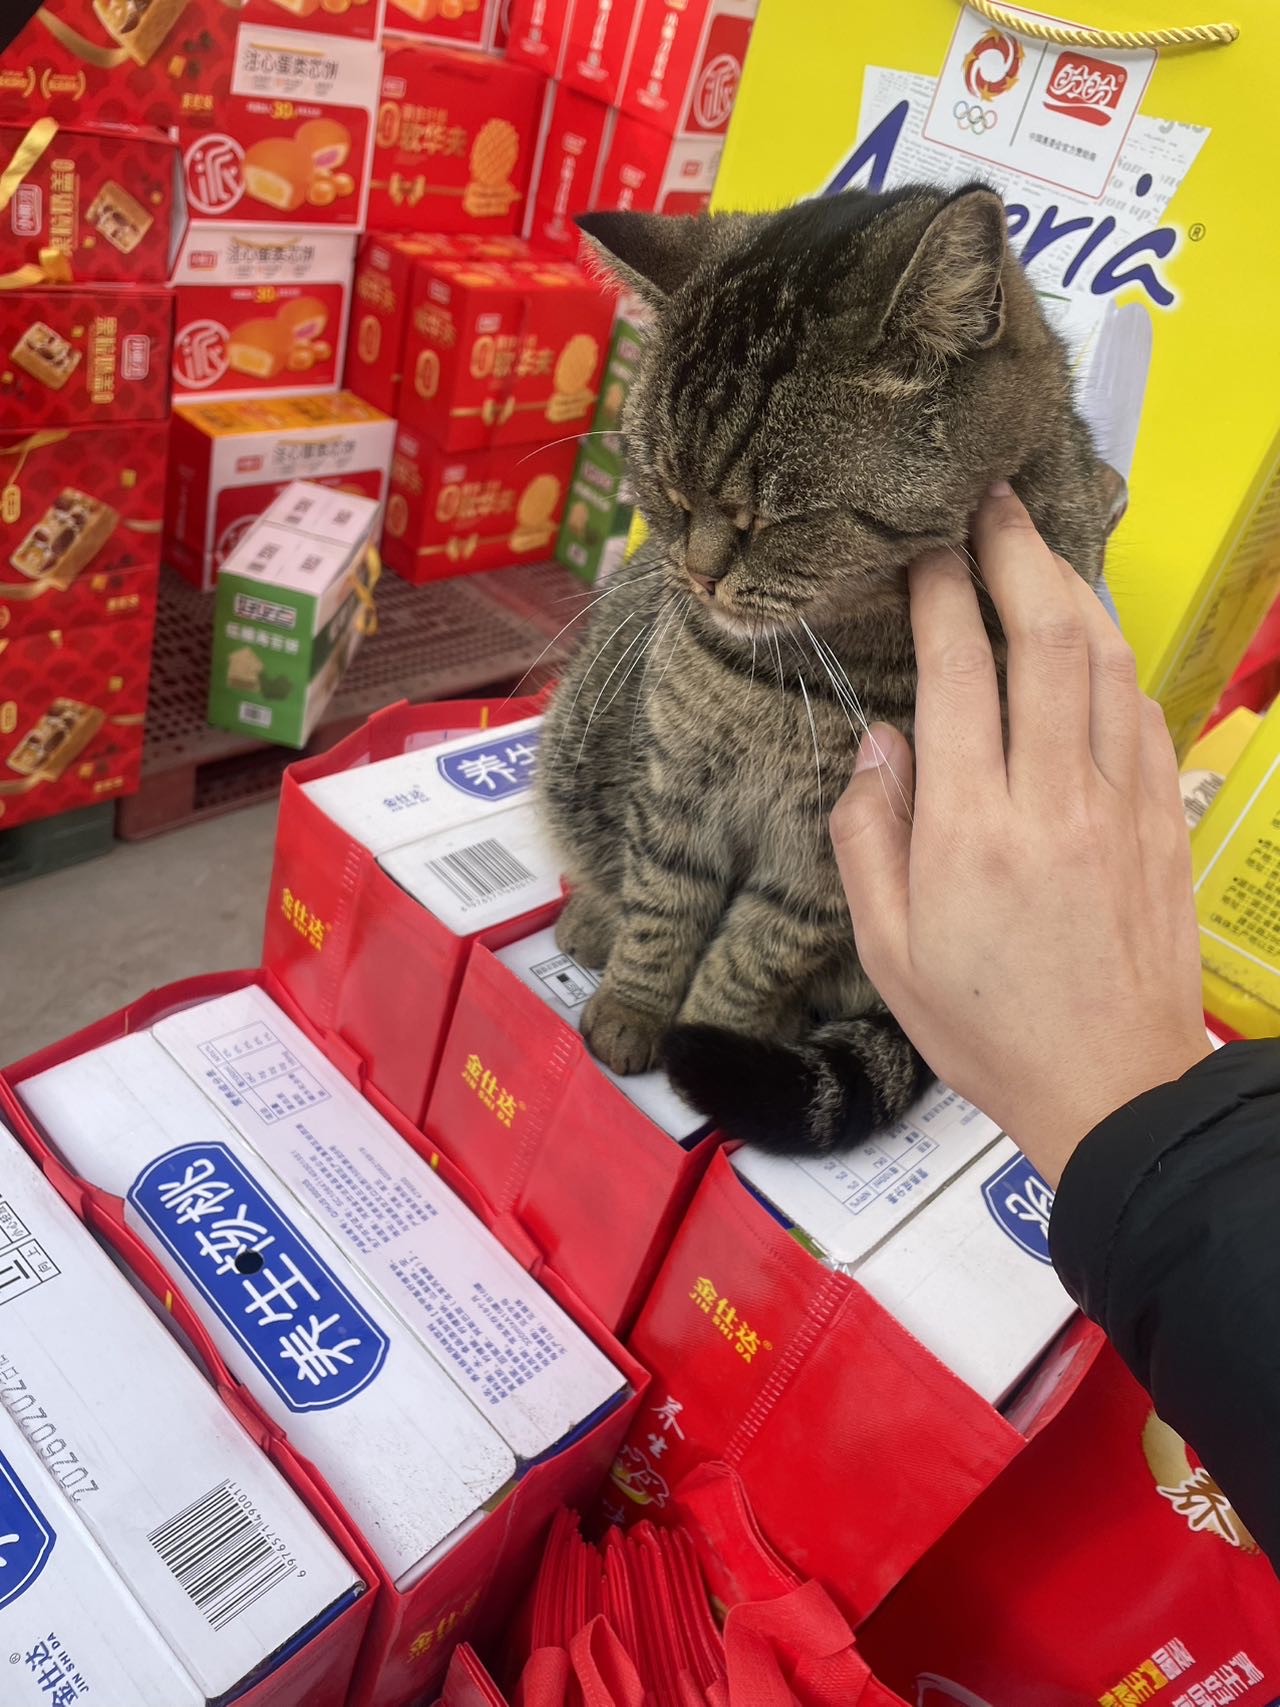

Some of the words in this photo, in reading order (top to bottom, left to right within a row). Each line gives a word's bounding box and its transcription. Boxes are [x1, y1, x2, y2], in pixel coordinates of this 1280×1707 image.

[283, 888, 324, 941] 金仕达
[465, 1055, 516, 1119] 金仕达
[885, 1167, 929, 1206] 营养成分表
[24, 1245, 53, 1276] 向上
[158, 1157, 361, 1386] 养生核桃
[687, 1289, 712, 1313] JIN
[709, 1314, 736, 1341] SHI
[732, 1342, 756, 1364] DA
[692, 1277, 764, 1354] 金仕达
[225, 1480, 265, 1523] 490011
[259, 1523, 299, 1567] 976571
[296, 1568, 308, 1580] 6
